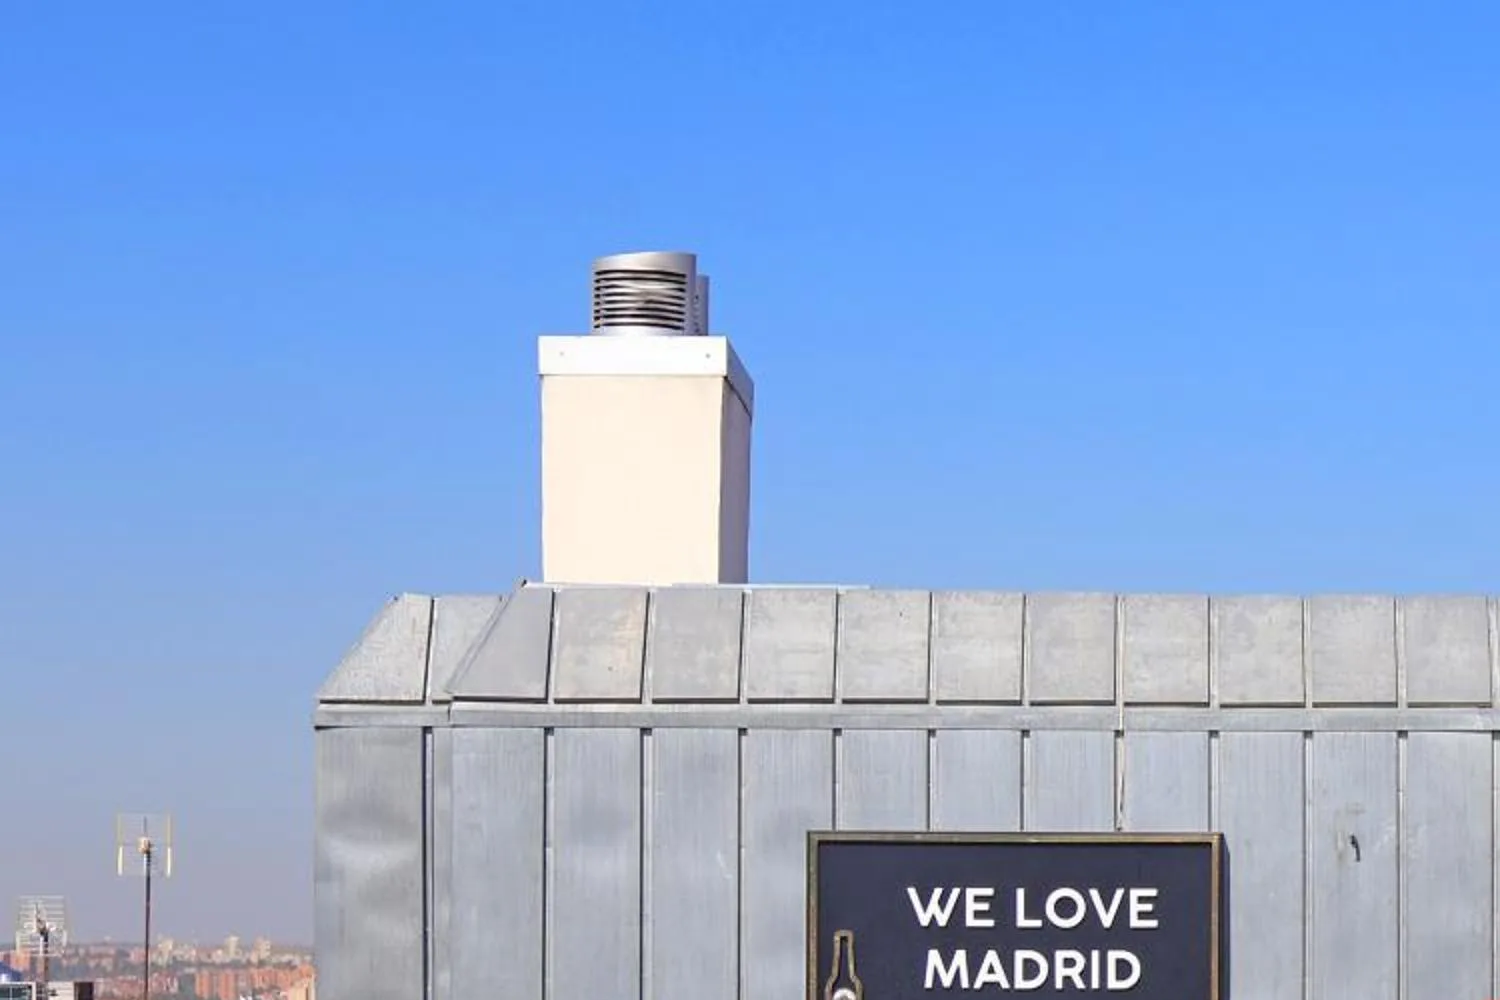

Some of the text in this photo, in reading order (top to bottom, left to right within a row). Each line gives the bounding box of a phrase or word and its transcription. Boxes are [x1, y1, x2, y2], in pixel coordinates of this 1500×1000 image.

[906, 886, 1159, 929] WE LOVE
[923, 948, 1141, 990] MADRID
